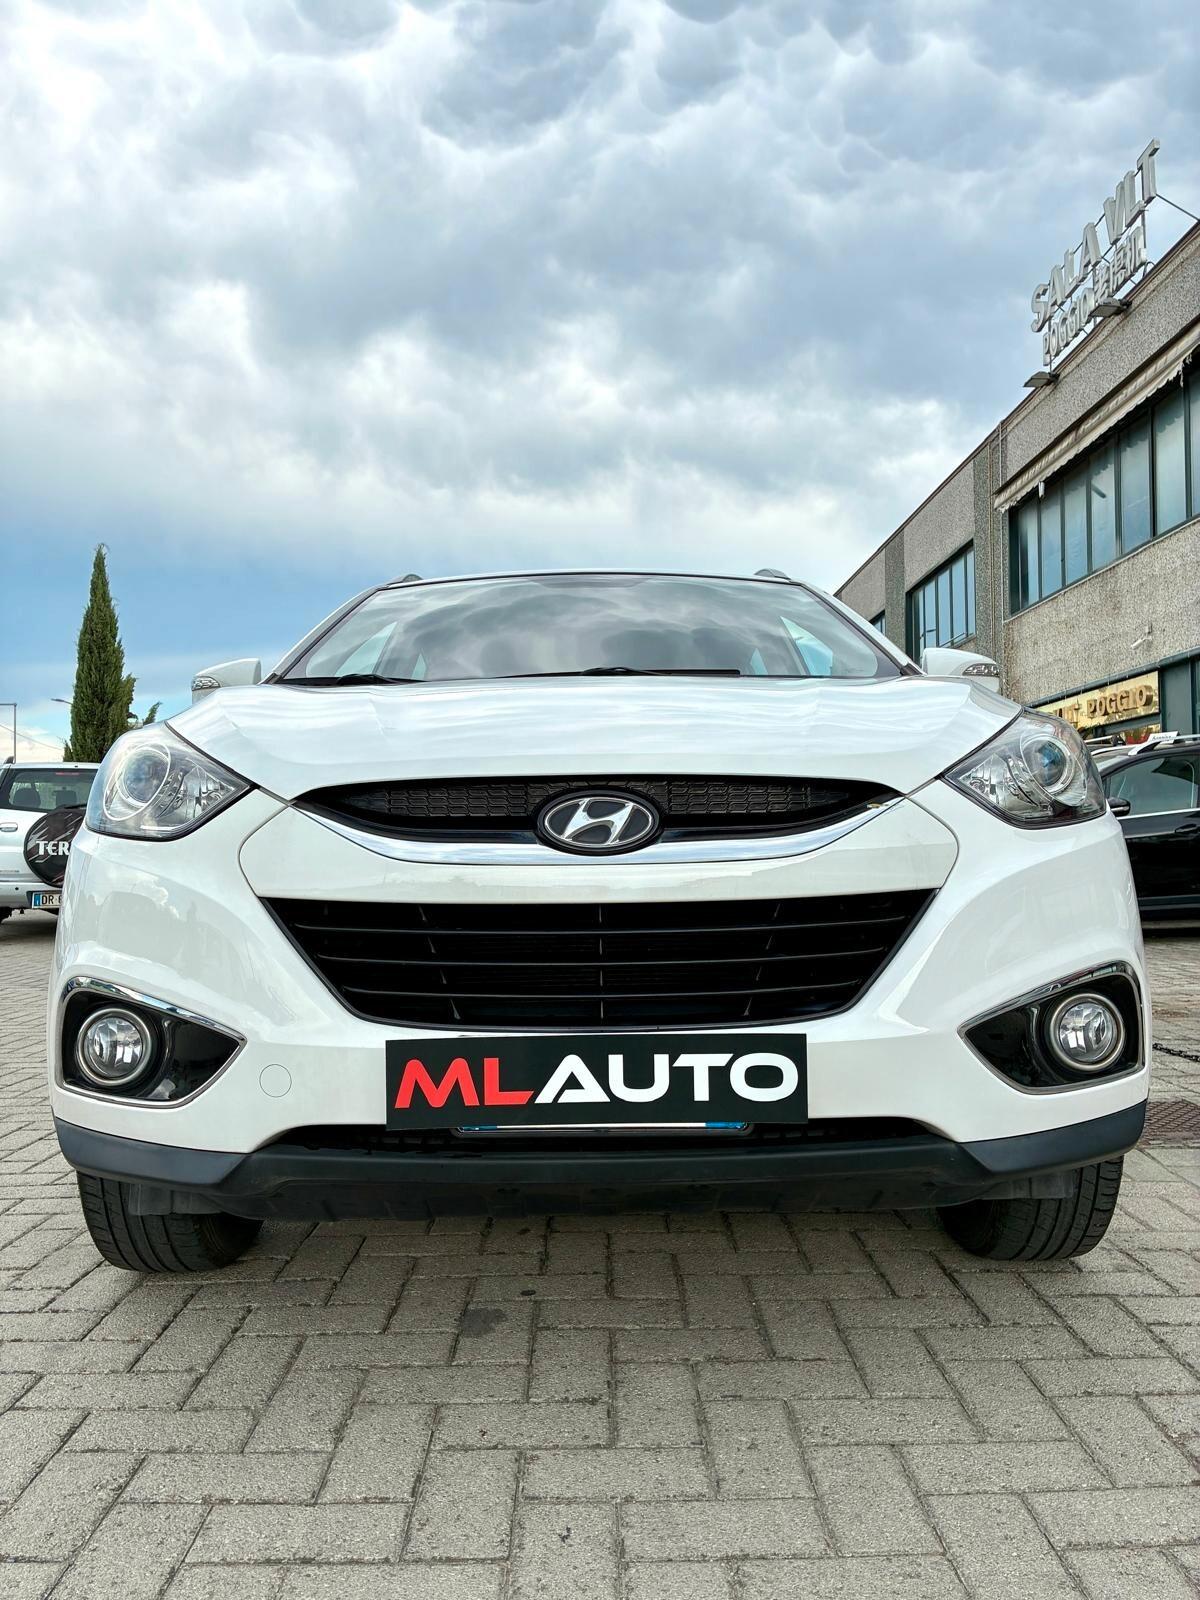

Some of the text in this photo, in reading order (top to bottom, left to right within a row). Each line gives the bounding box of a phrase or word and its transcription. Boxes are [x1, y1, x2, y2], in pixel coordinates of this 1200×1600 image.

[1031, 137, 1161, 333] SALA VLT
[1042, 287, 1095, 367] POGGIO
[1087, 685, 1153, 719] POGGIO
